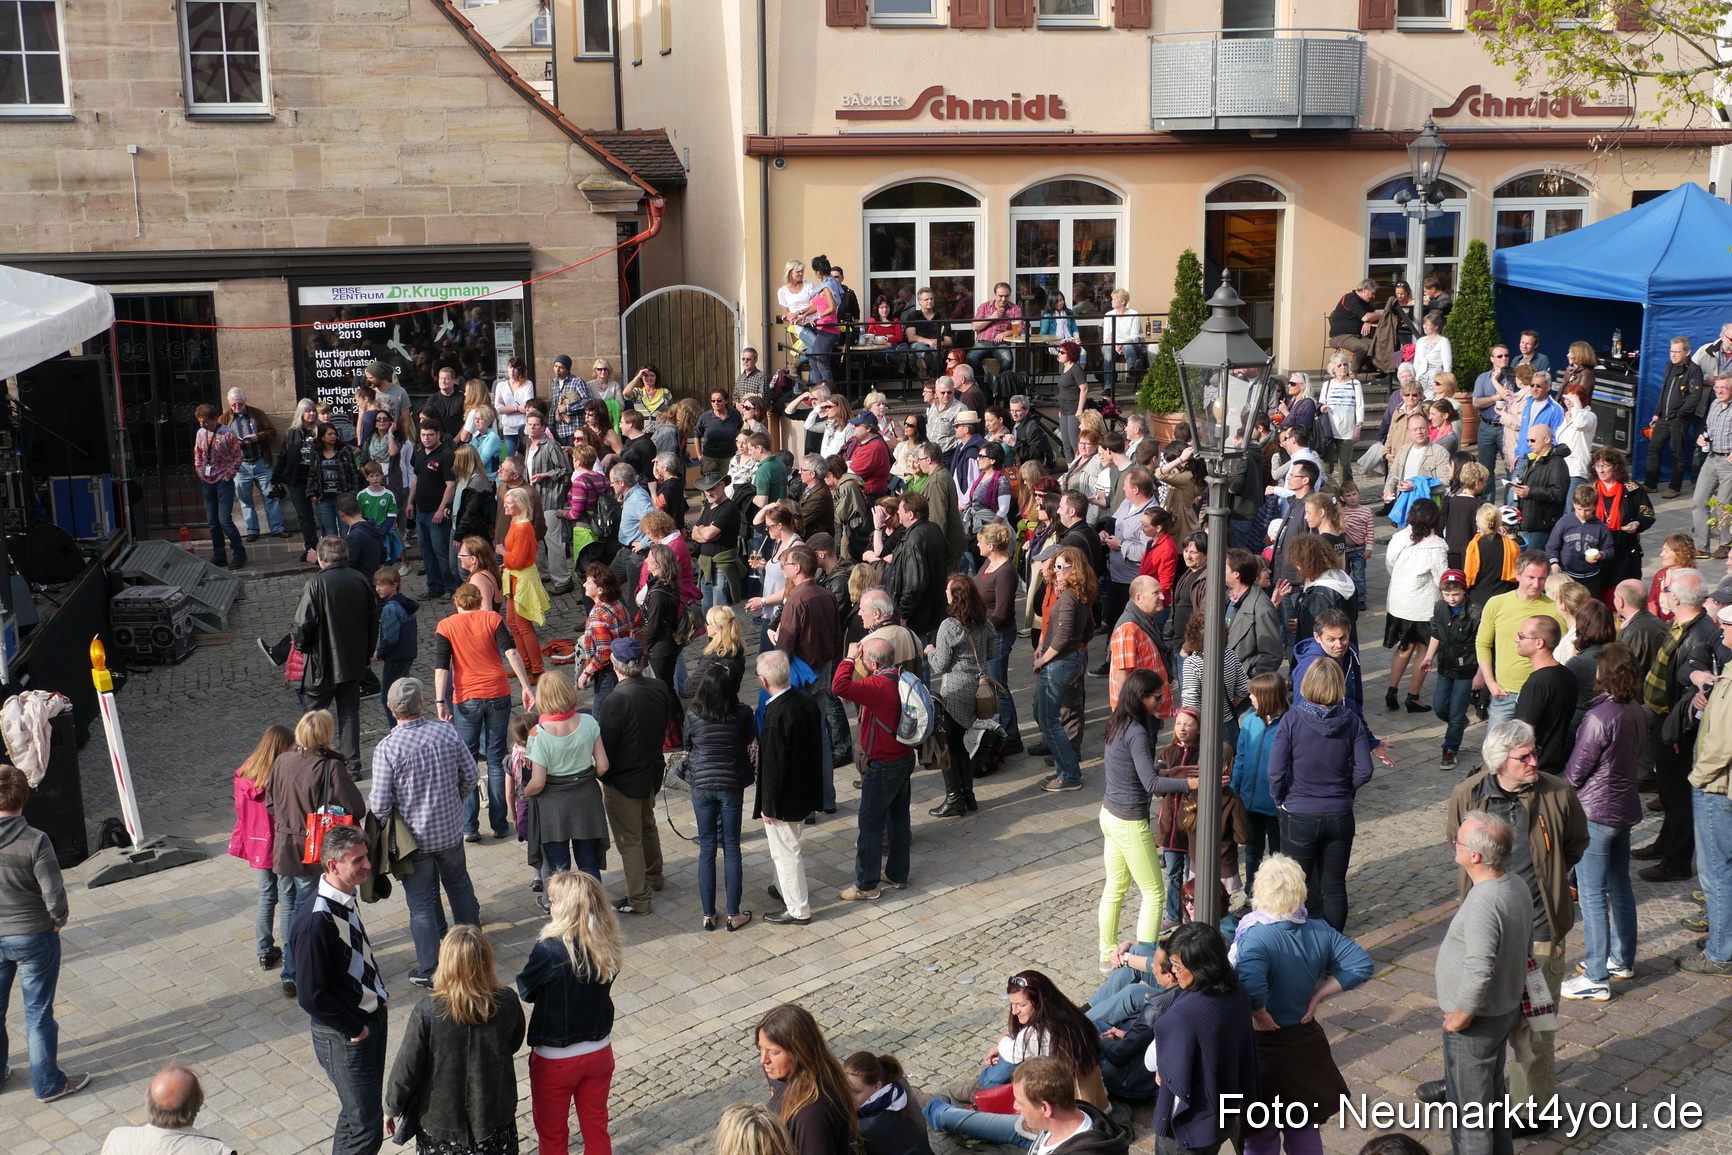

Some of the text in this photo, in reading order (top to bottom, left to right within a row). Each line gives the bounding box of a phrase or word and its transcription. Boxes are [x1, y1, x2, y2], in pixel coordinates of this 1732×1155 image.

[836, 85, 1066, 121] Schmidt
[1433, 85, 1633, 117] Schmidt
[332, 292, 384, 300] ZENTRUM
[313, 320, 386, 331] Gruppenreisen
[338, 330, 362, 339] 2013
[315, 349, 371, 359] Hurtigruten
[316, 360, 332, 368] MS
[318, 397, 333, 405] MS
